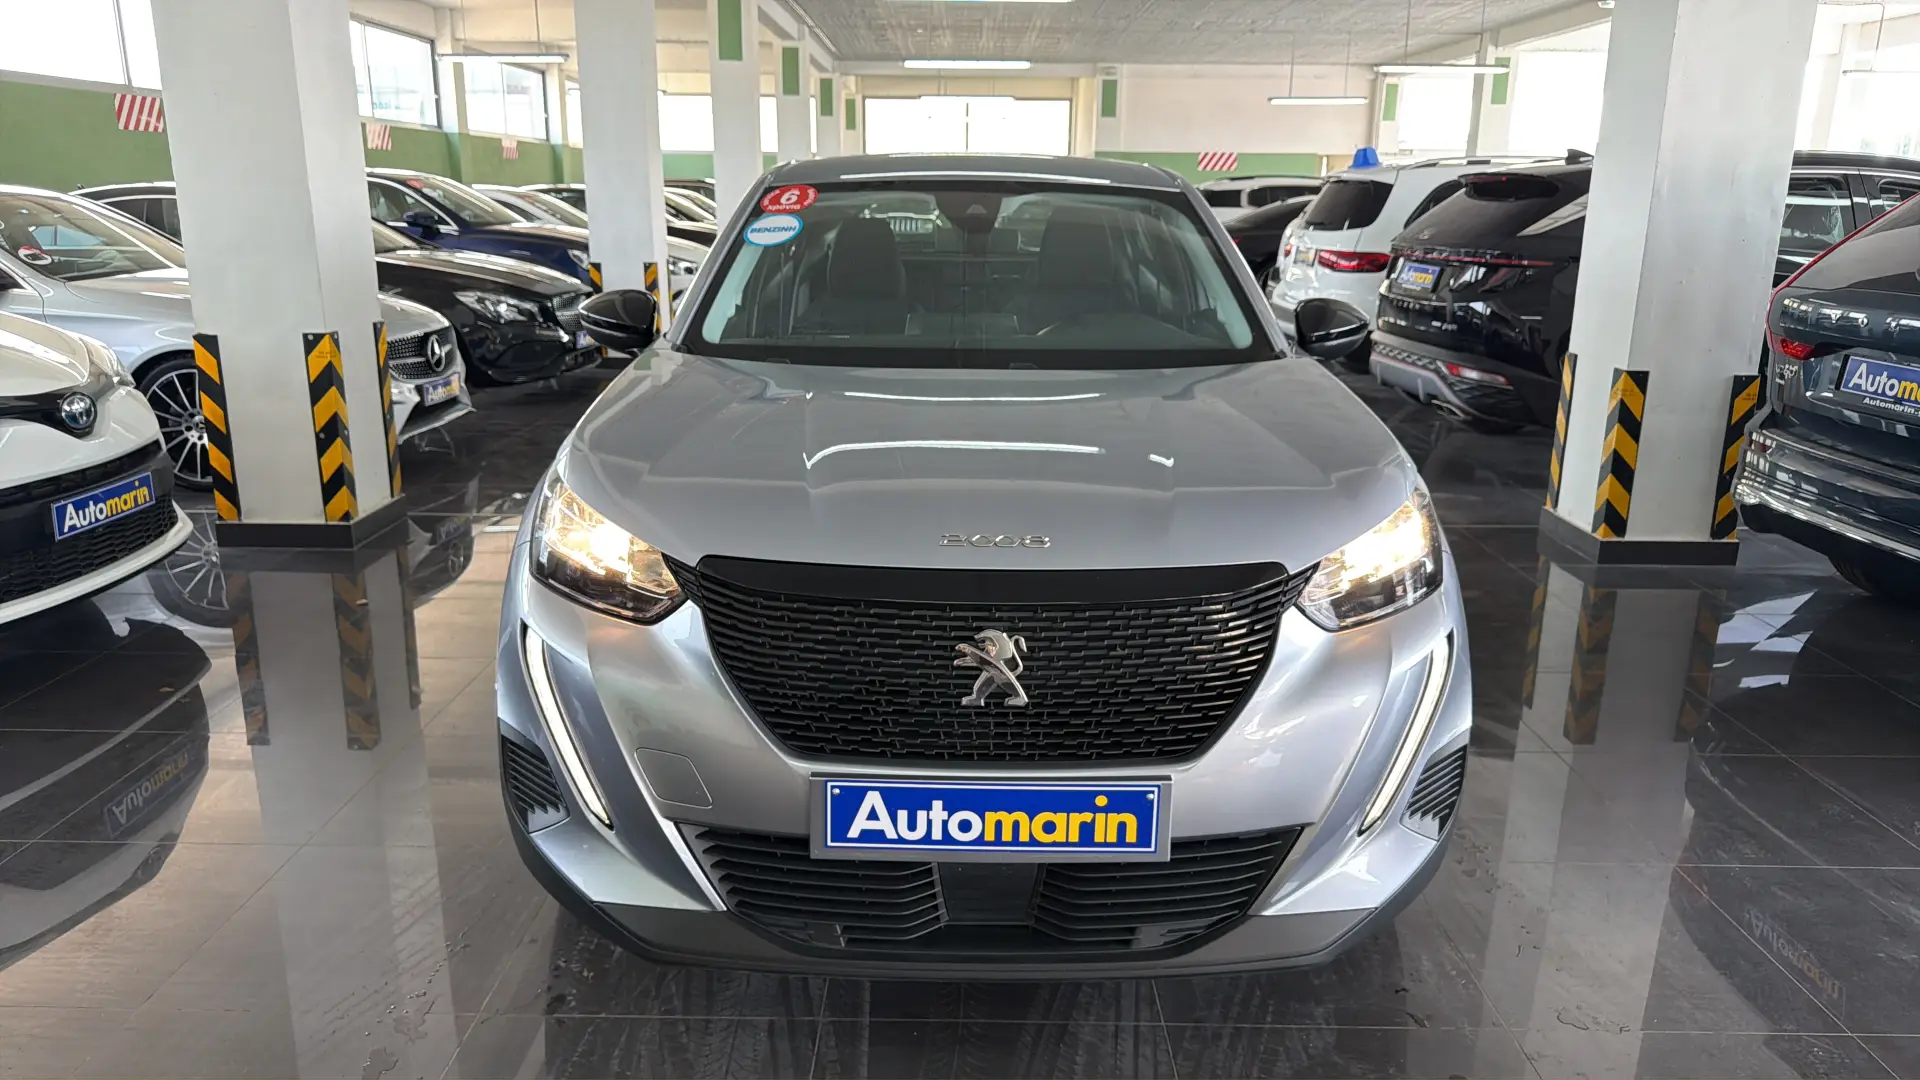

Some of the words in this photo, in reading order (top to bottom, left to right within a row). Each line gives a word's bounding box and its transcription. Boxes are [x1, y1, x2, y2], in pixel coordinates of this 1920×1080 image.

[780, 188, 800, 205] 6
[63, 480, 150, 533] Automarin
[939, 533, 1050, 548] 2008
[847, 790, 1137, 843] Automarin
